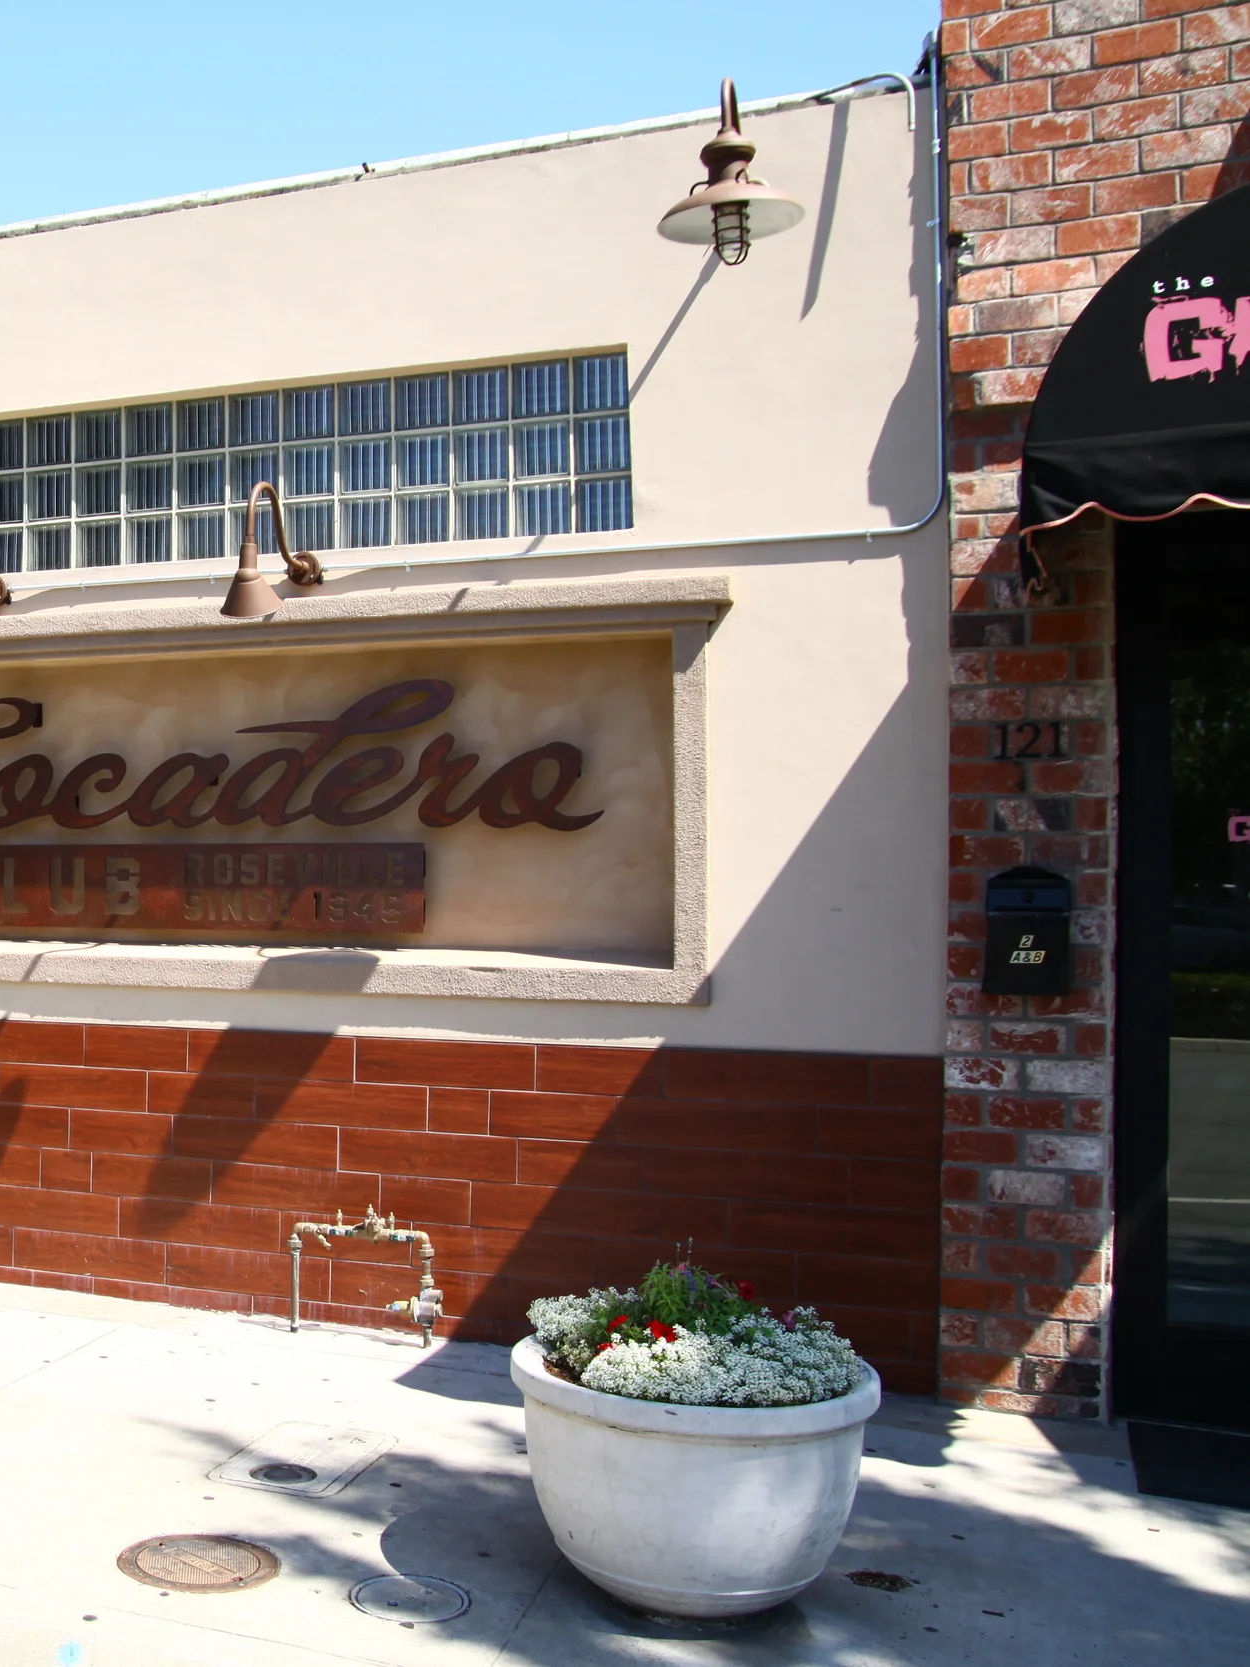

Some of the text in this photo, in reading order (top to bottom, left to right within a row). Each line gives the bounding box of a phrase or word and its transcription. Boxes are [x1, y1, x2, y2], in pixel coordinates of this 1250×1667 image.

[1152, 275, 1215, 294] the
[993, 722, 1068, 760] 121
[184, 853, 405, 886] ROSEVILLE
[184, 890, 294, 922] SINCE
[1020, 935, 1032, 947] 2
